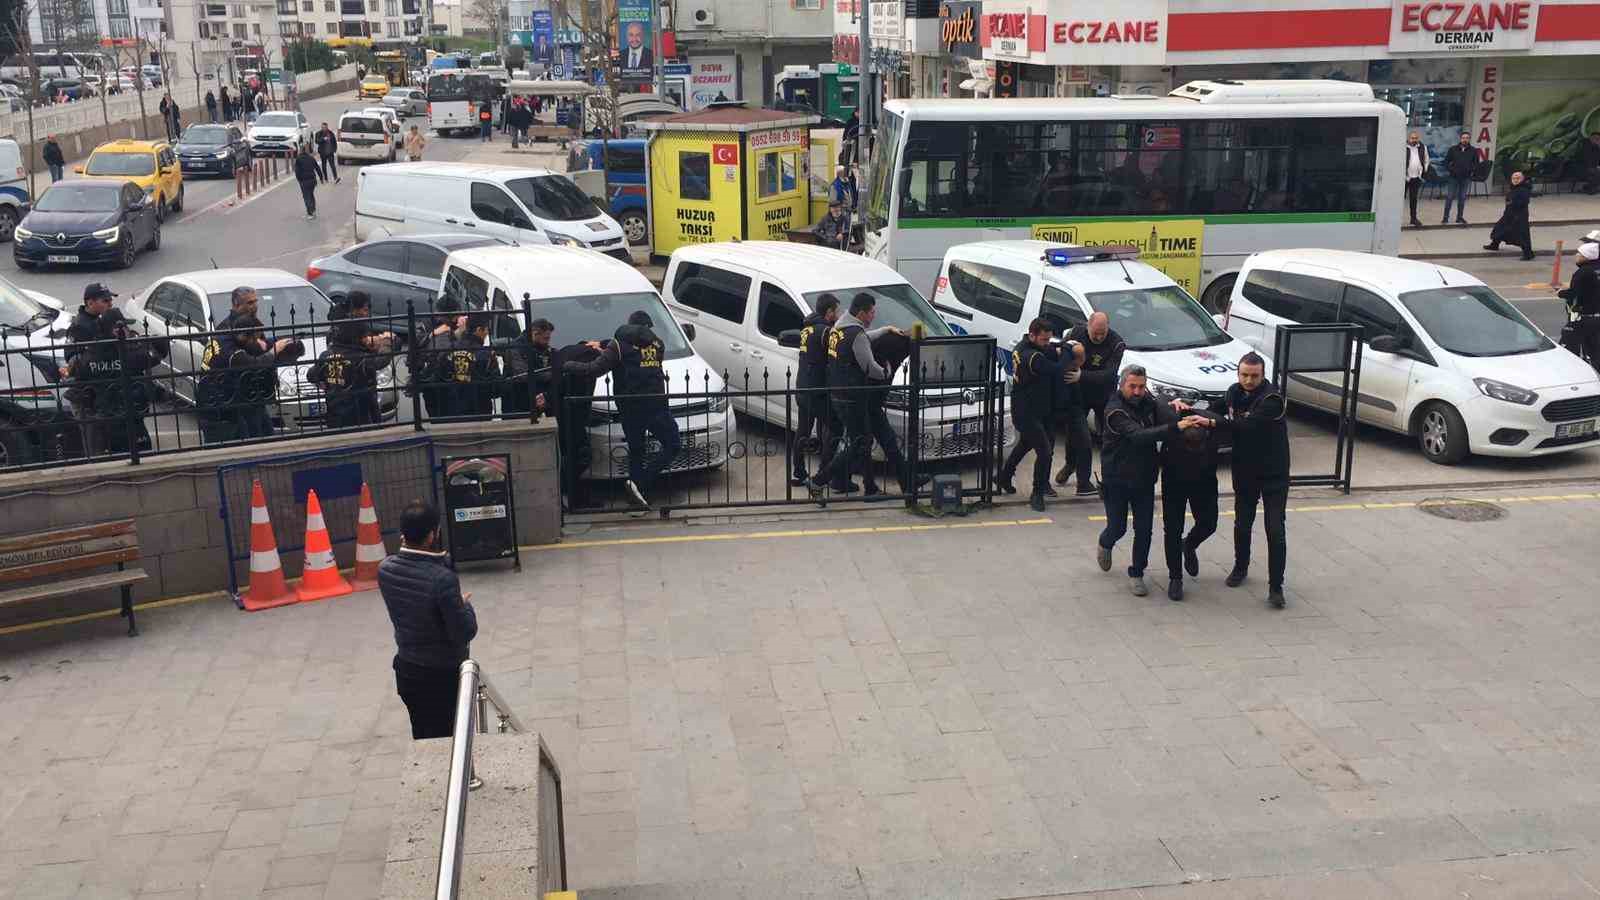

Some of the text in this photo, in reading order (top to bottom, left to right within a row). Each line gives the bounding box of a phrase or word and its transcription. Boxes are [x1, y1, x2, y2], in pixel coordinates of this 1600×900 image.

[1401, 2, 1530, 32] ECZANE
[942, 6, 974, 52] optik
[989, 13, 1026, 38] ECZANE
[1053, 20, 1158, 43] ECZANE
[1435, 32, 1494, 44] DERMAN
[701, 63, 722, 72] DEVA
[1475, 67, 1497, 162] ECZAN
[676, 208, 716, 222] HUZUR
[765, 206, 792, 221] HUZUR
[680, 222, 713, 236] TAKSİ
[1160, 237, 1197, 251] TIME
